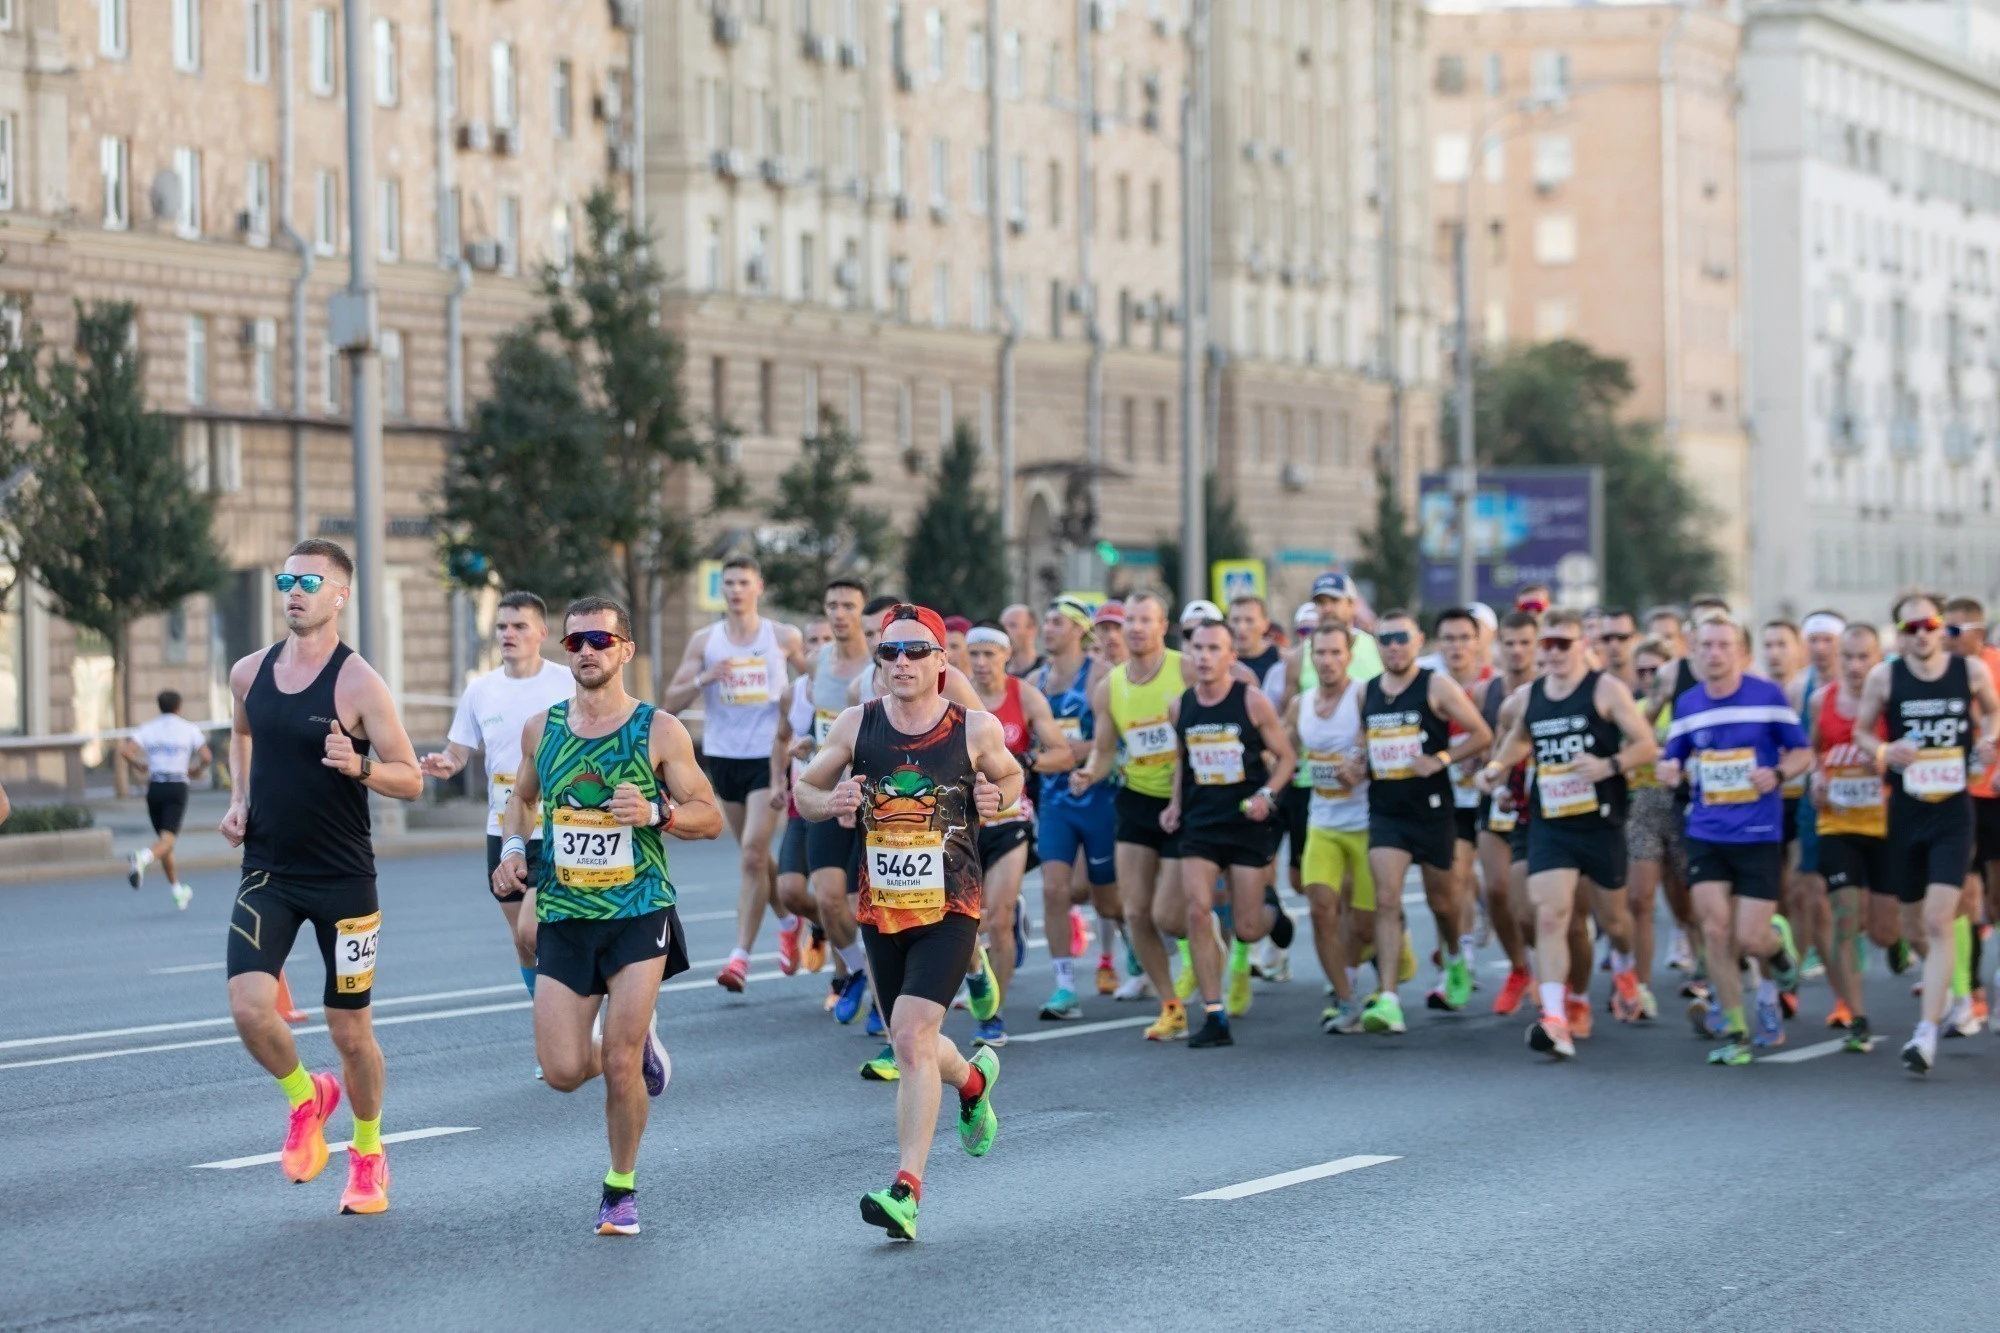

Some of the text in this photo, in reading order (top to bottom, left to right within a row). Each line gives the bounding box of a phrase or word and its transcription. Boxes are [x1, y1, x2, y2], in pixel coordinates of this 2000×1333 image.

[1137, 727, 1168, 746] 768
[563, 832, 621, 855] 3737
[576, 857, 608, 866] АЛЕКСЕЙ
[877, 853, 932, 877] 5462
[886, 878, 921, 887] ВАЛЕНТИН
[346, 976, 355, 988] B
